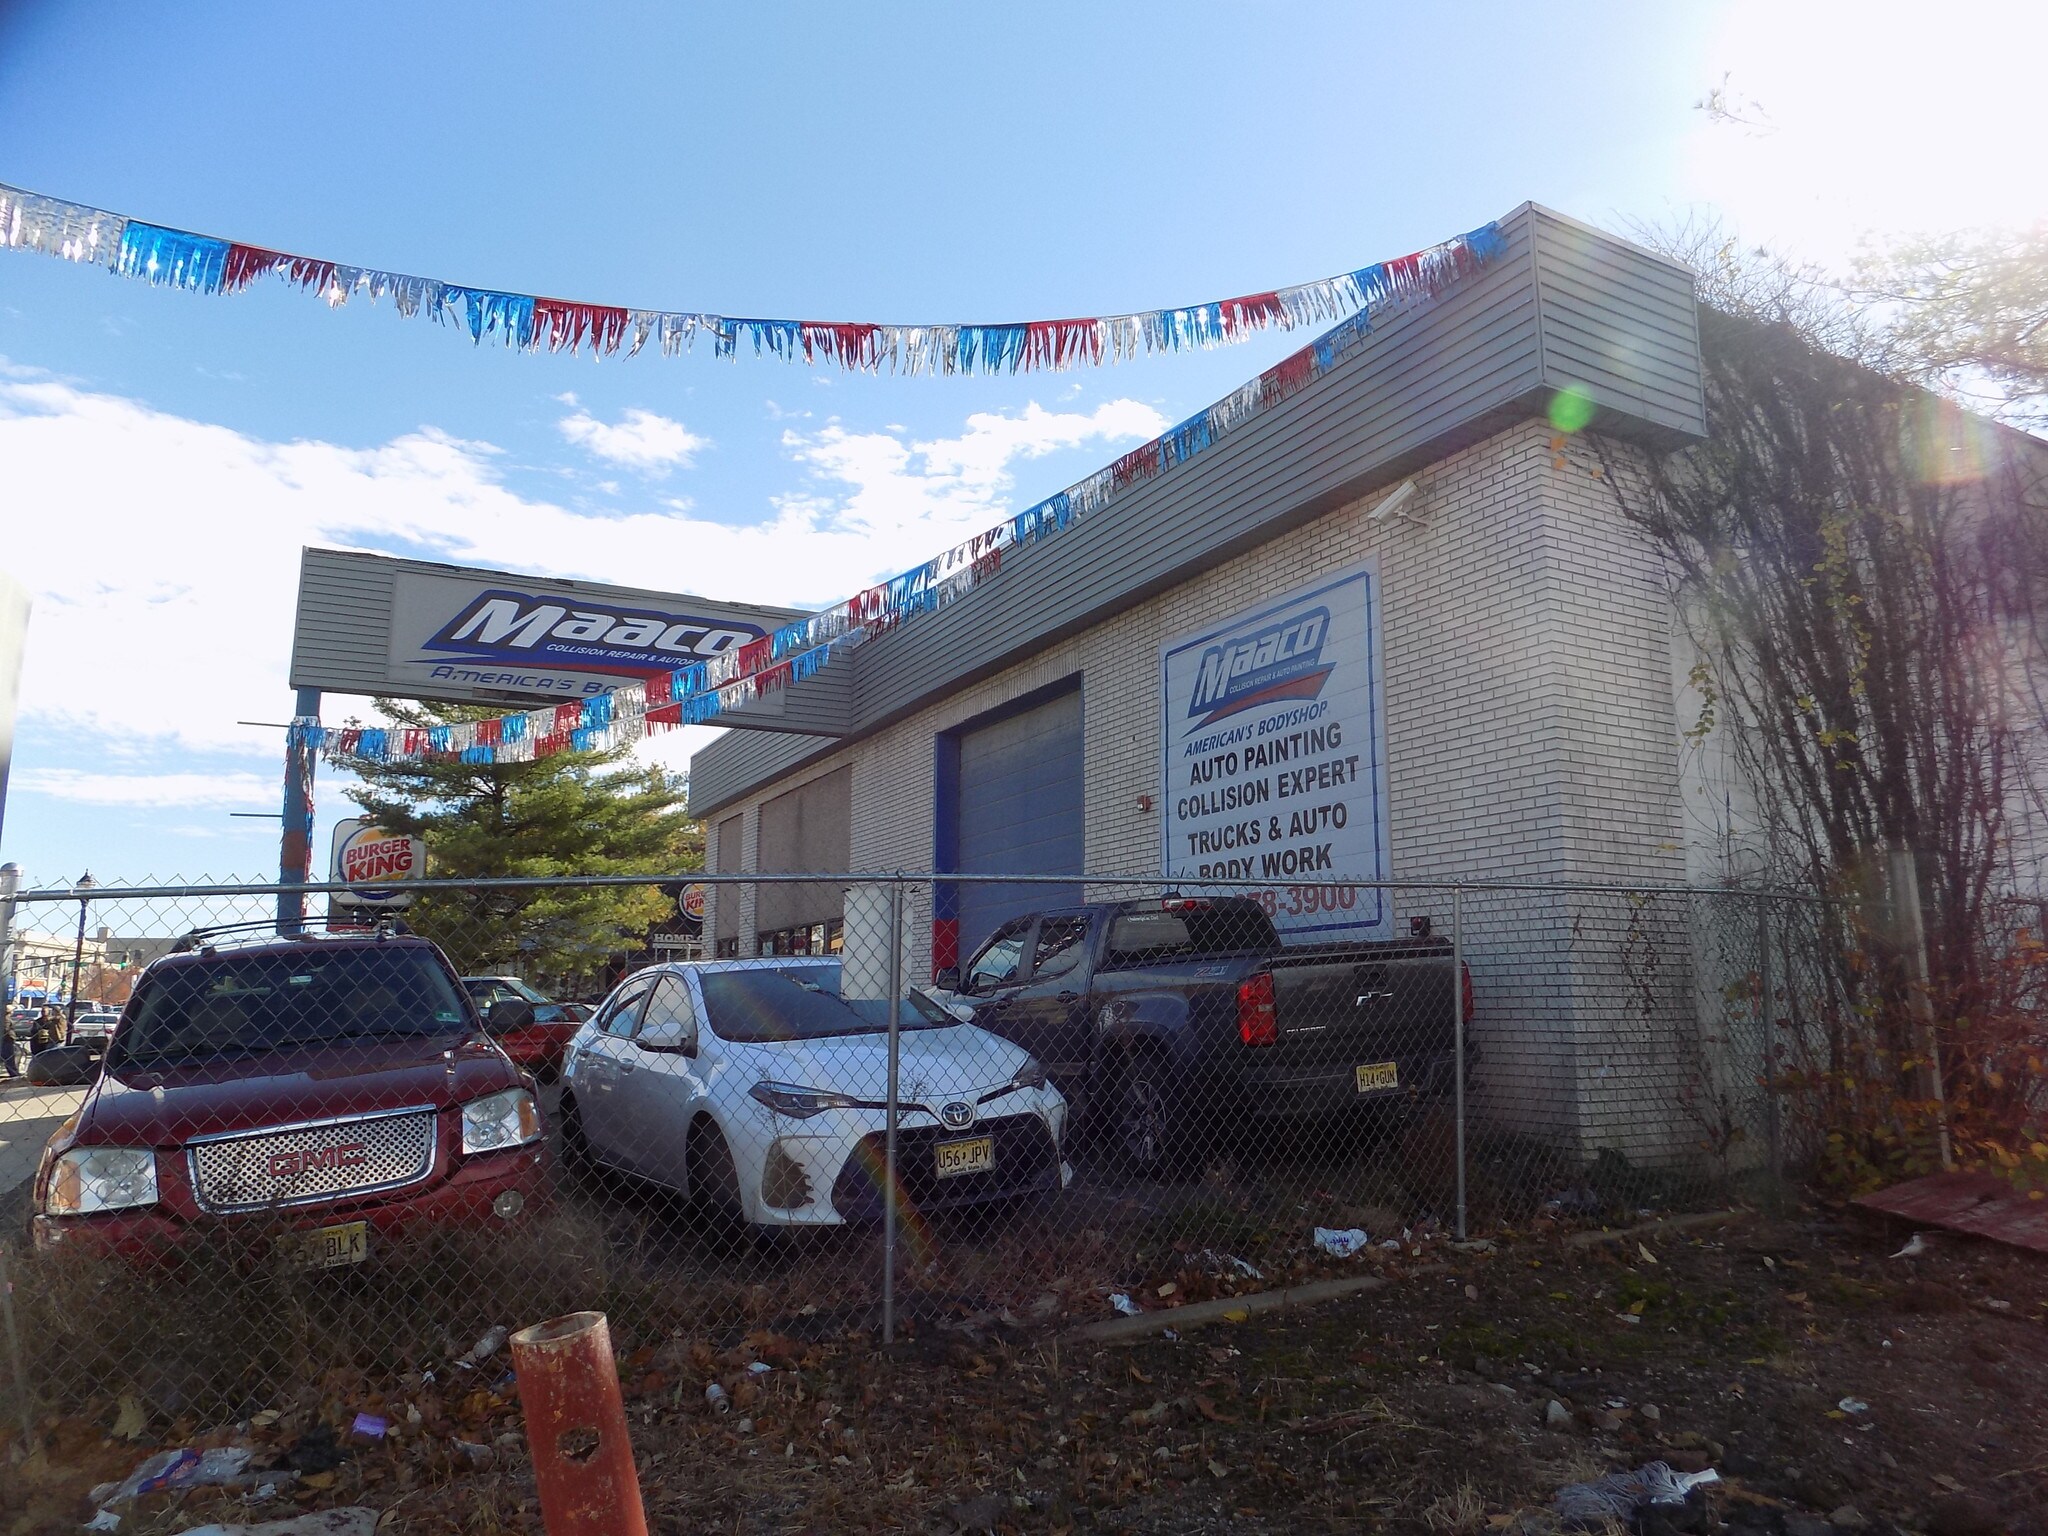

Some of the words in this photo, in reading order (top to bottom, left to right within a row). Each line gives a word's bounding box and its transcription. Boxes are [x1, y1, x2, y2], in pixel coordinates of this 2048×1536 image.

[450, 599, 754, 655] Maaco
[547, 643, 607, 657] COLLISION
[607, 650, 648, 661] REPAIR
[658, 656, 695, 665] AUTOP
[1195, 614, 1324, 707] Maaco
[1229, 680, 1254, 694] COLLISION
[1276, 665, 1291, 677] AUTO
[1184, 724, 1254, 757] AMERICAN'S
[1257, 701, 1328, 736] BODYSHOP
[1190, 752, 1238, 786] AUTO
[1244, 722, 1342, 771] PAINTING
[1177, 777, 1269, 821] COLLISION
[1278, 755, 1359, 798] EXPERT
[1187, 819, 1261, 856] TRUCKS
[1268, 816, 1282, 841] &
[1289, 802, 1347, 837] AUTO
[346, 839, 411, 864] BURGER
[348, 852, 413, 882] KING
[1199, 856, 1254, 885] BODY
[1262, 843, 1332, 878] WORK
[685, 898, 704, 910] KIN
[1235, 886, 1356, 917] 8-3900
[654, 934, 694, 942] HOME
[269, 1143, 365, 1177] GMC
[938, 1150, 961, 1168] U56
[969, 1145, 989, 1164] JPV
